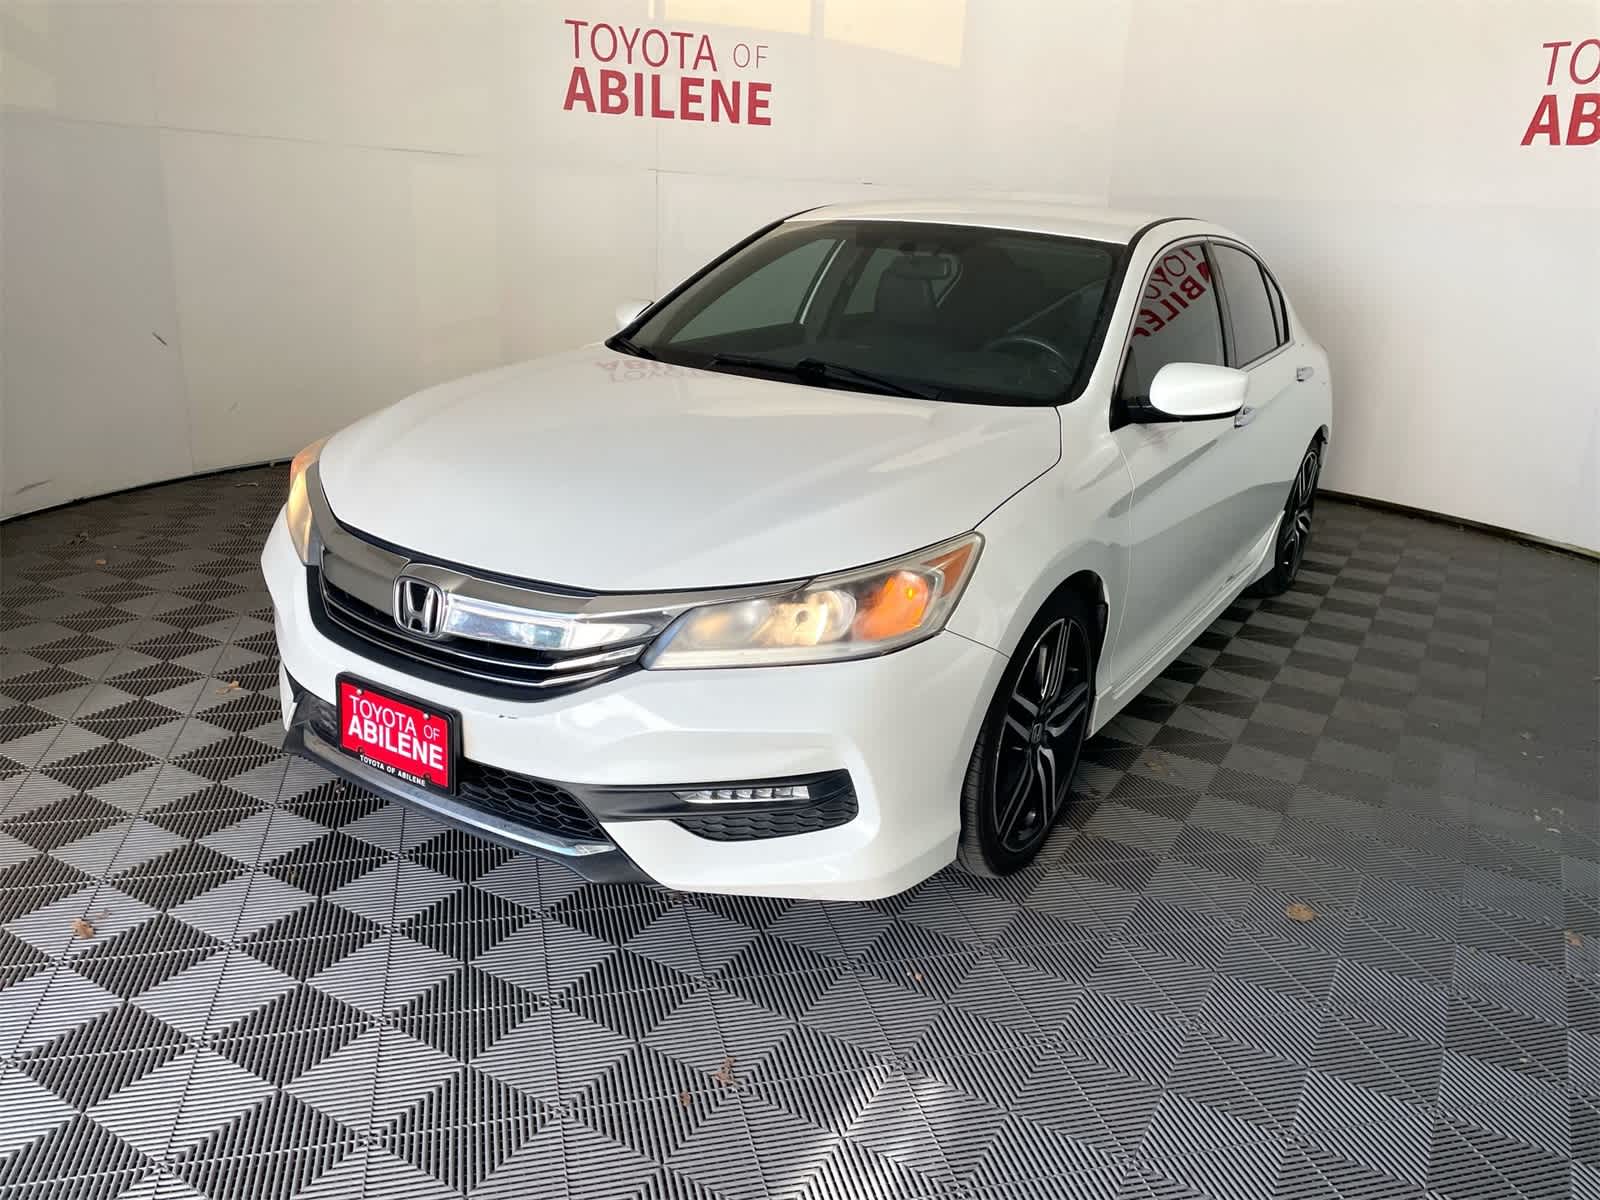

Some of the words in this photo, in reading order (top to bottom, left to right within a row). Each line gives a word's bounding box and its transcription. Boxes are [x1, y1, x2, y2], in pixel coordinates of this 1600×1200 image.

[564, 19, 718, 72] TOYOTA
[733, 43, 769, 69] OF
[563, 66, 772, 126] ABILENE
[348, 715, 443, 770] ABILENE
[349, 695, 417, 737] TOYOTA
[423, 724, 440, 740] OF
[359, 754, 385, 771] TOYOTA
[386, 765, 396, 774] OF
[397, 770, 426, 787] ABILENE
